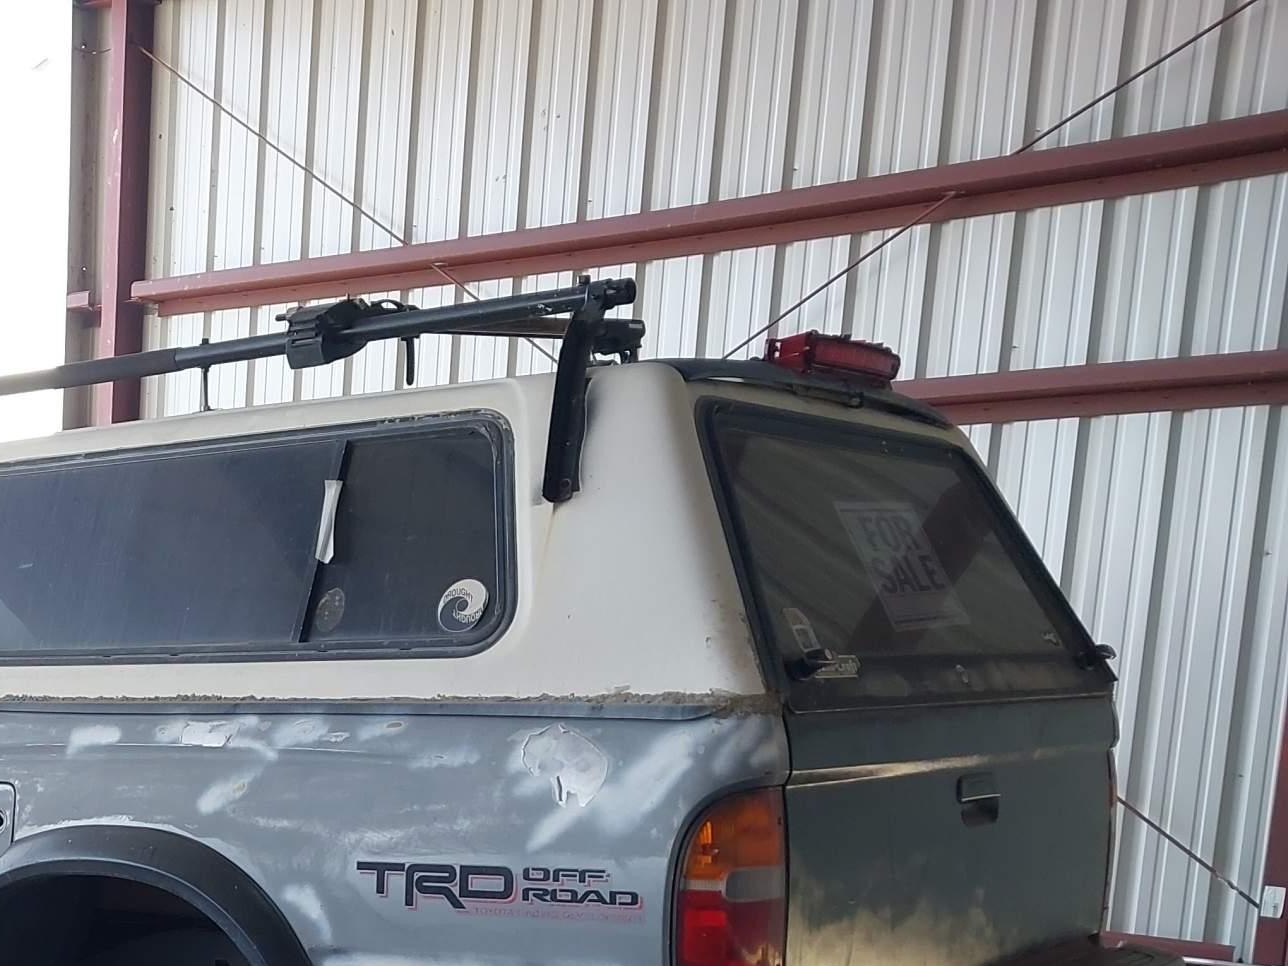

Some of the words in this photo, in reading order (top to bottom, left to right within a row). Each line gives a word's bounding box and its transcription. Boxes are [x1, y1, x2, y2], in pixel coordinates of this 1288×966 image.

[858, 514, 920, 552] FOR
[873, 553, 947, 593] SALE
[357, 861, 514, 910] TRD
[522, 867, 606, 883] OFF
[521, 887, 640, 906] ROAD
